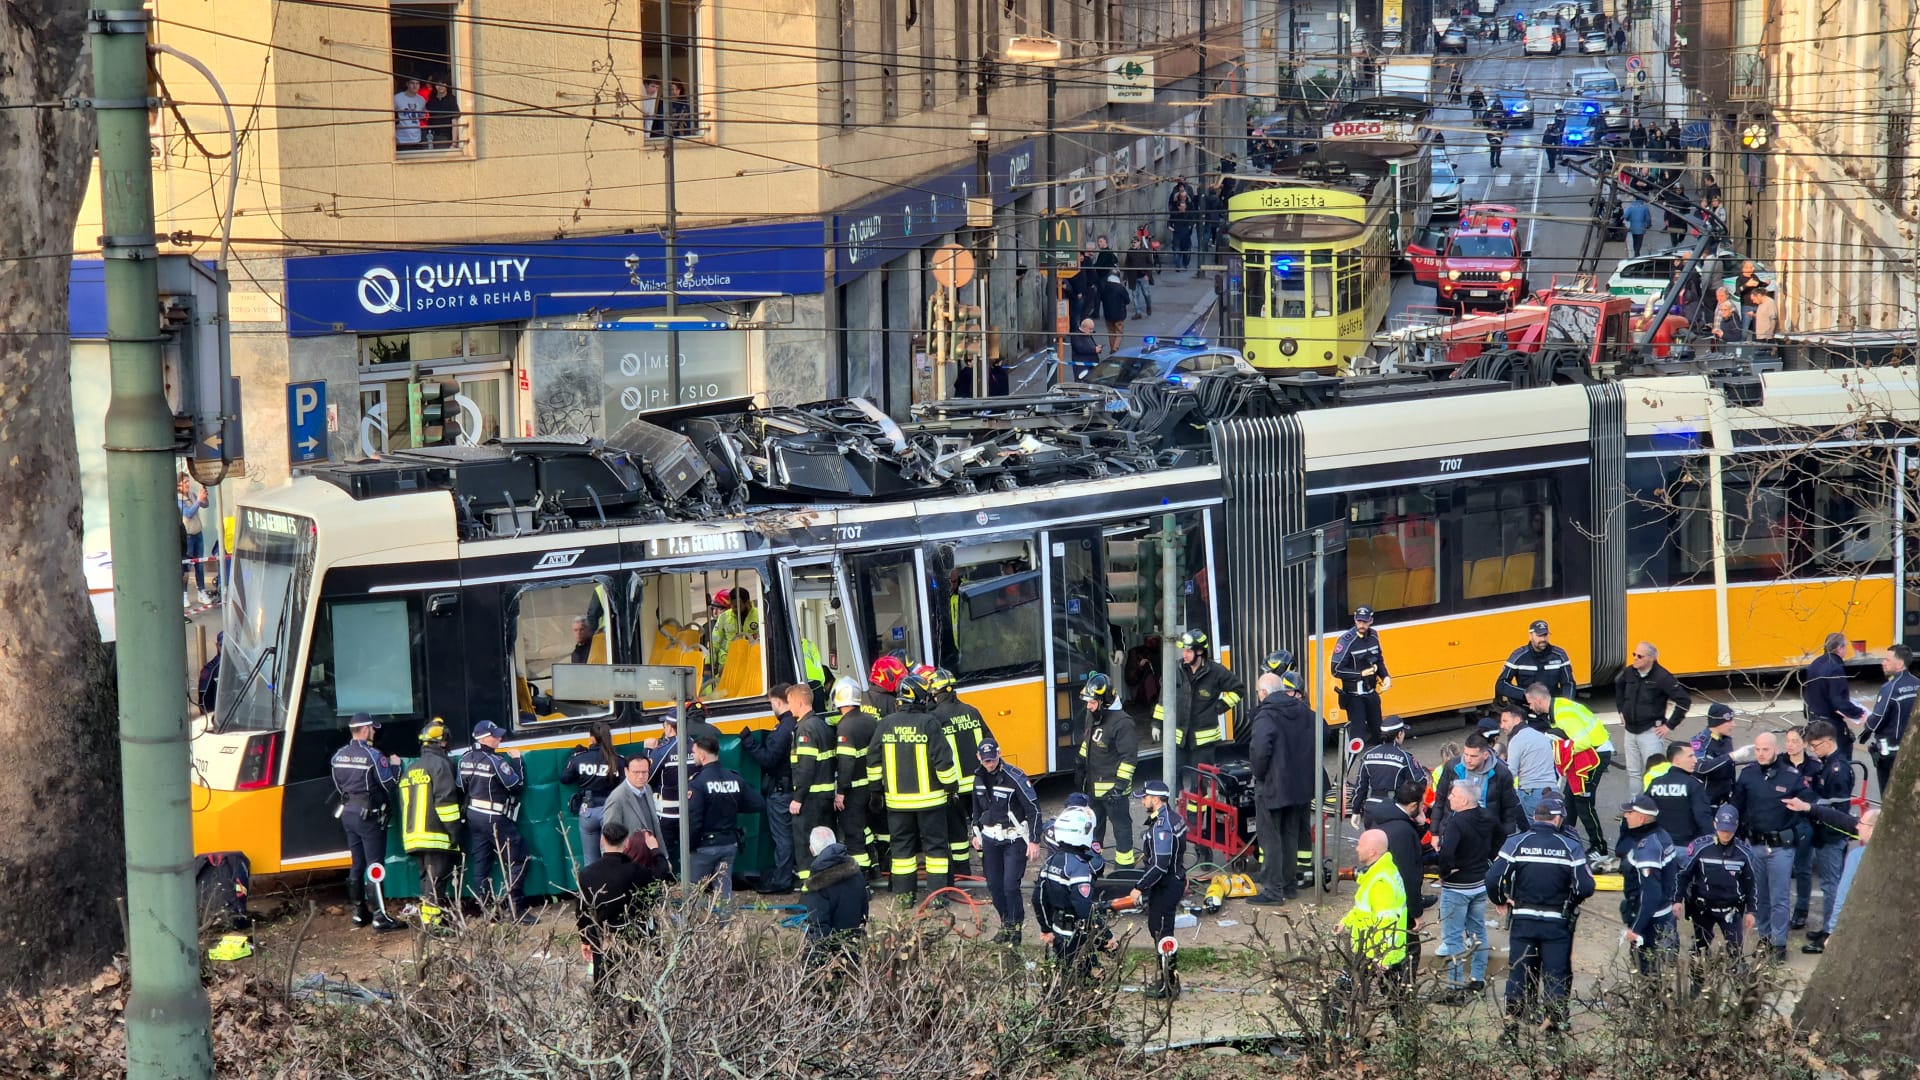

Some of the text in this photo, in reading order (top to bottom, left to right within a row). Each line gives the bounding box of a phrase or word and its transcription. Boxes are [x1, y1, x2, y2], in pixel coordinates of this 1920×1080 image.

[1261, 194, 1325, 207] idealista
[859, 216, 881, 241] QUALITY
[415, 258, 530, 293] QUALITY
[416, 290, 532, 311] SPORT & REHAB
[296, 387, 318, 426] P
[1440, 458, 1462, 471] 7707
[894, 726, 917, 735] VIGILI
[899, 734, 928, 743] FUOCO
[707, 780, 740, 793] POLIZIA
[1651, 784, 1687, 796] POLIZIA
[1521, 847, 1566, 857] POLIZIA LOCALE
